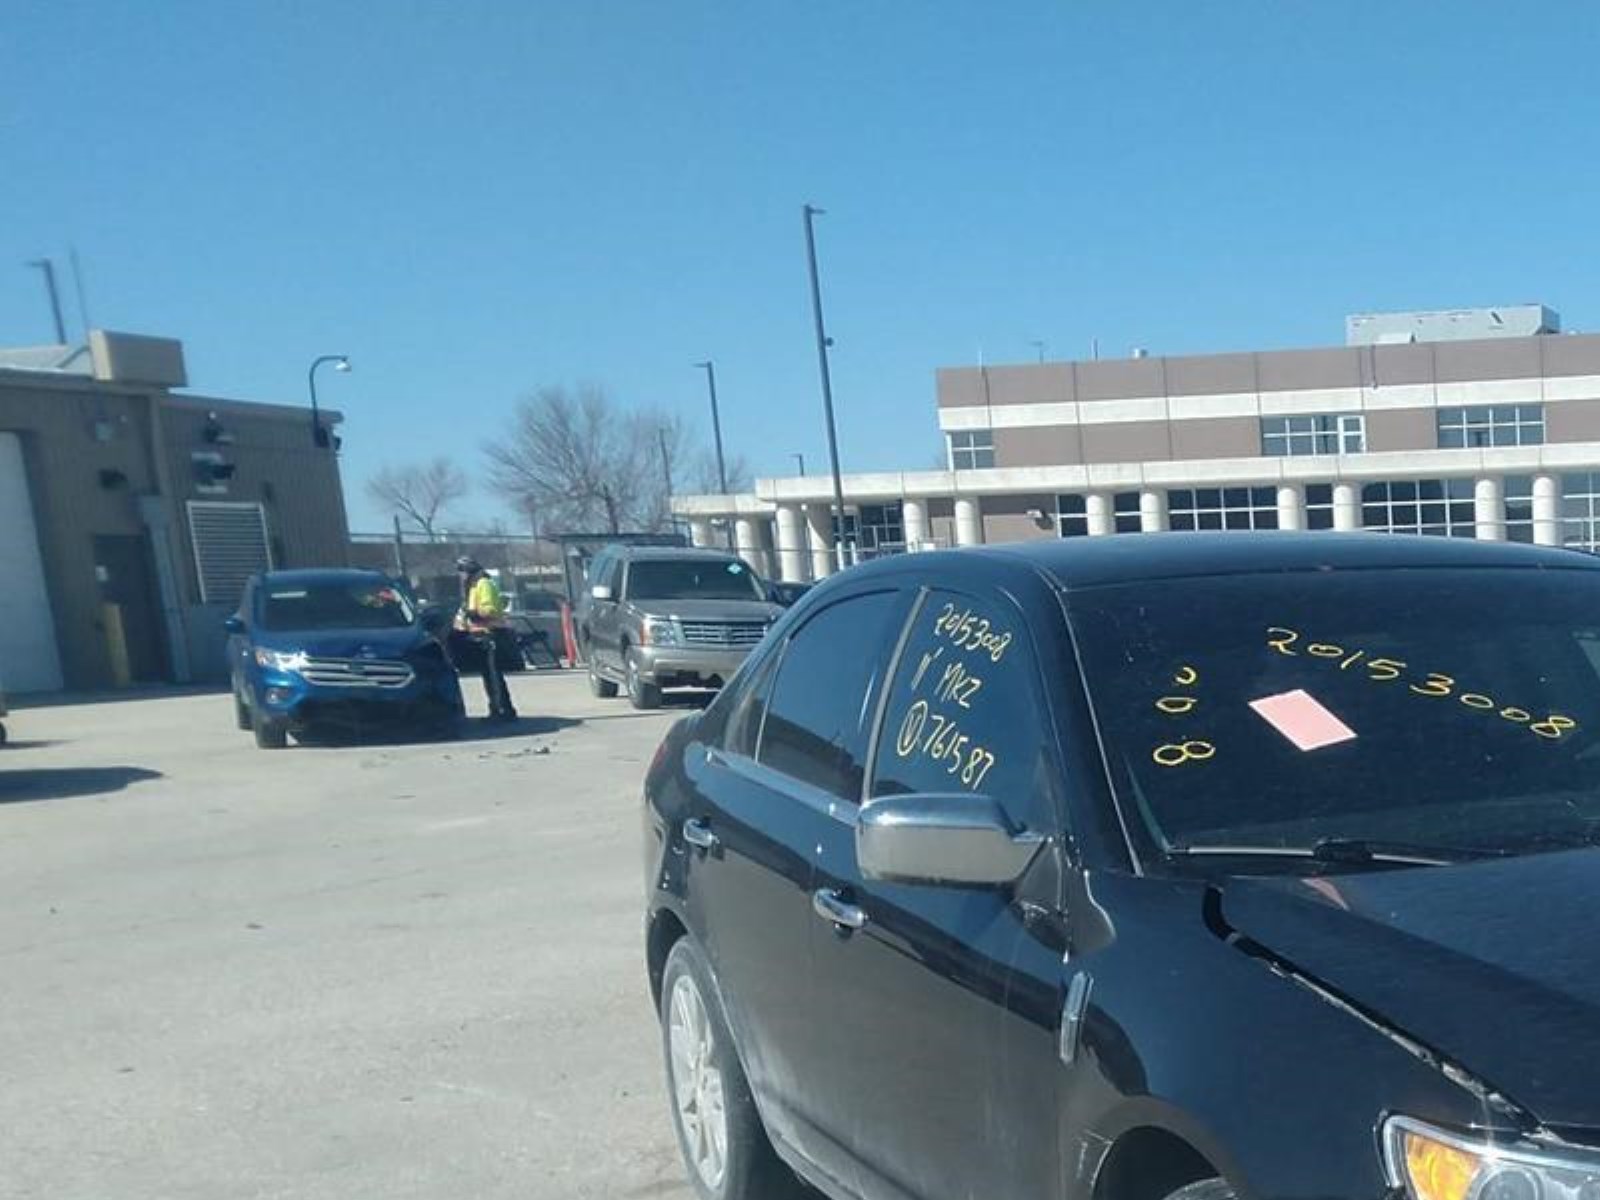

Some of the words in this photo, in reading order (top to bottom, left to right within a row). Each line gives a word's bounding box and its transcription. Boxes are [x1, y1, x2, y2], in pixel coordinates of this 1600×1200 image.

[934, 603, 1012, 662] 20153008
[1267, 626, 1577, 739] 20153008
[922, 714, 994, 790] 761587
